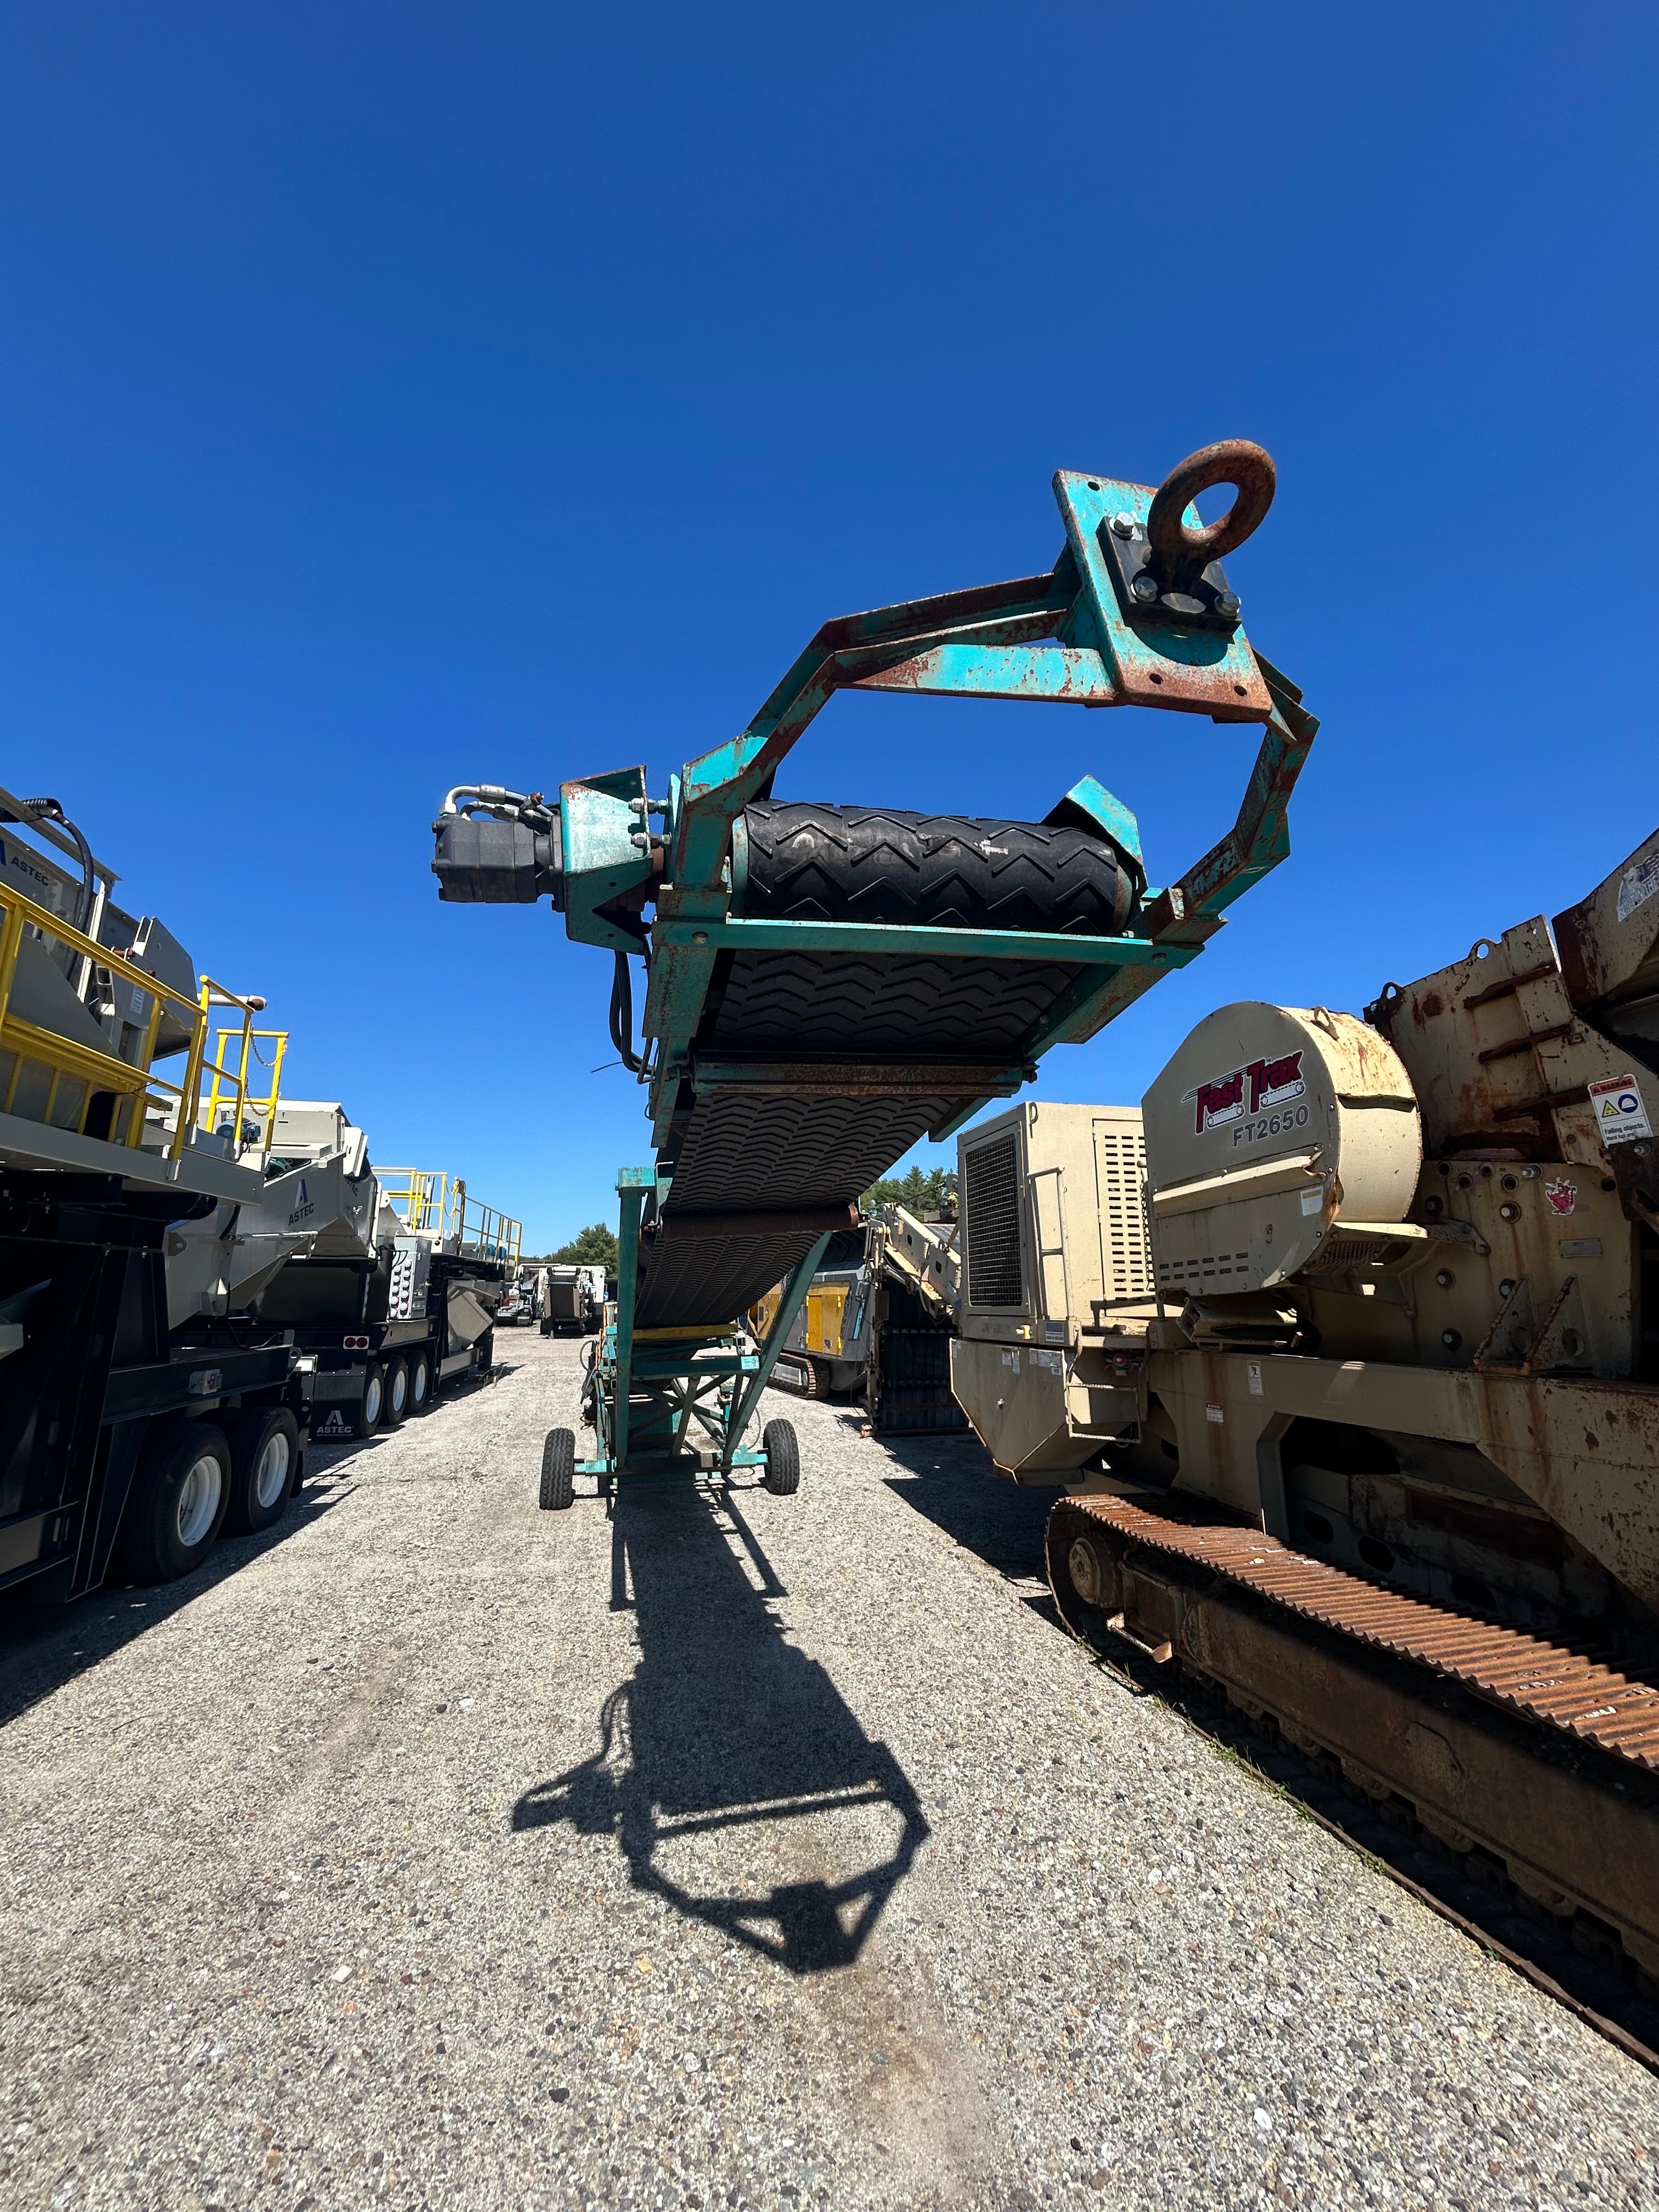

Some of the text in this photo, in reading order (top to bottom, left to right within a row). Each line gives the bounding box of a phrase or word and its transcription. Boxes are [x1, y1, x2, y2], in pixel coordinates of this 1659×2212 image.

[11, 856, 49, 886] ASTEC
[1196, 1051, 1303, 1133] Fast Trax
[1600, 1079, 1632, 1092] WARNING
[1233, 1105, 1308, 1147] FT2650
[288, 1203, 314, 1226] ASTEC
